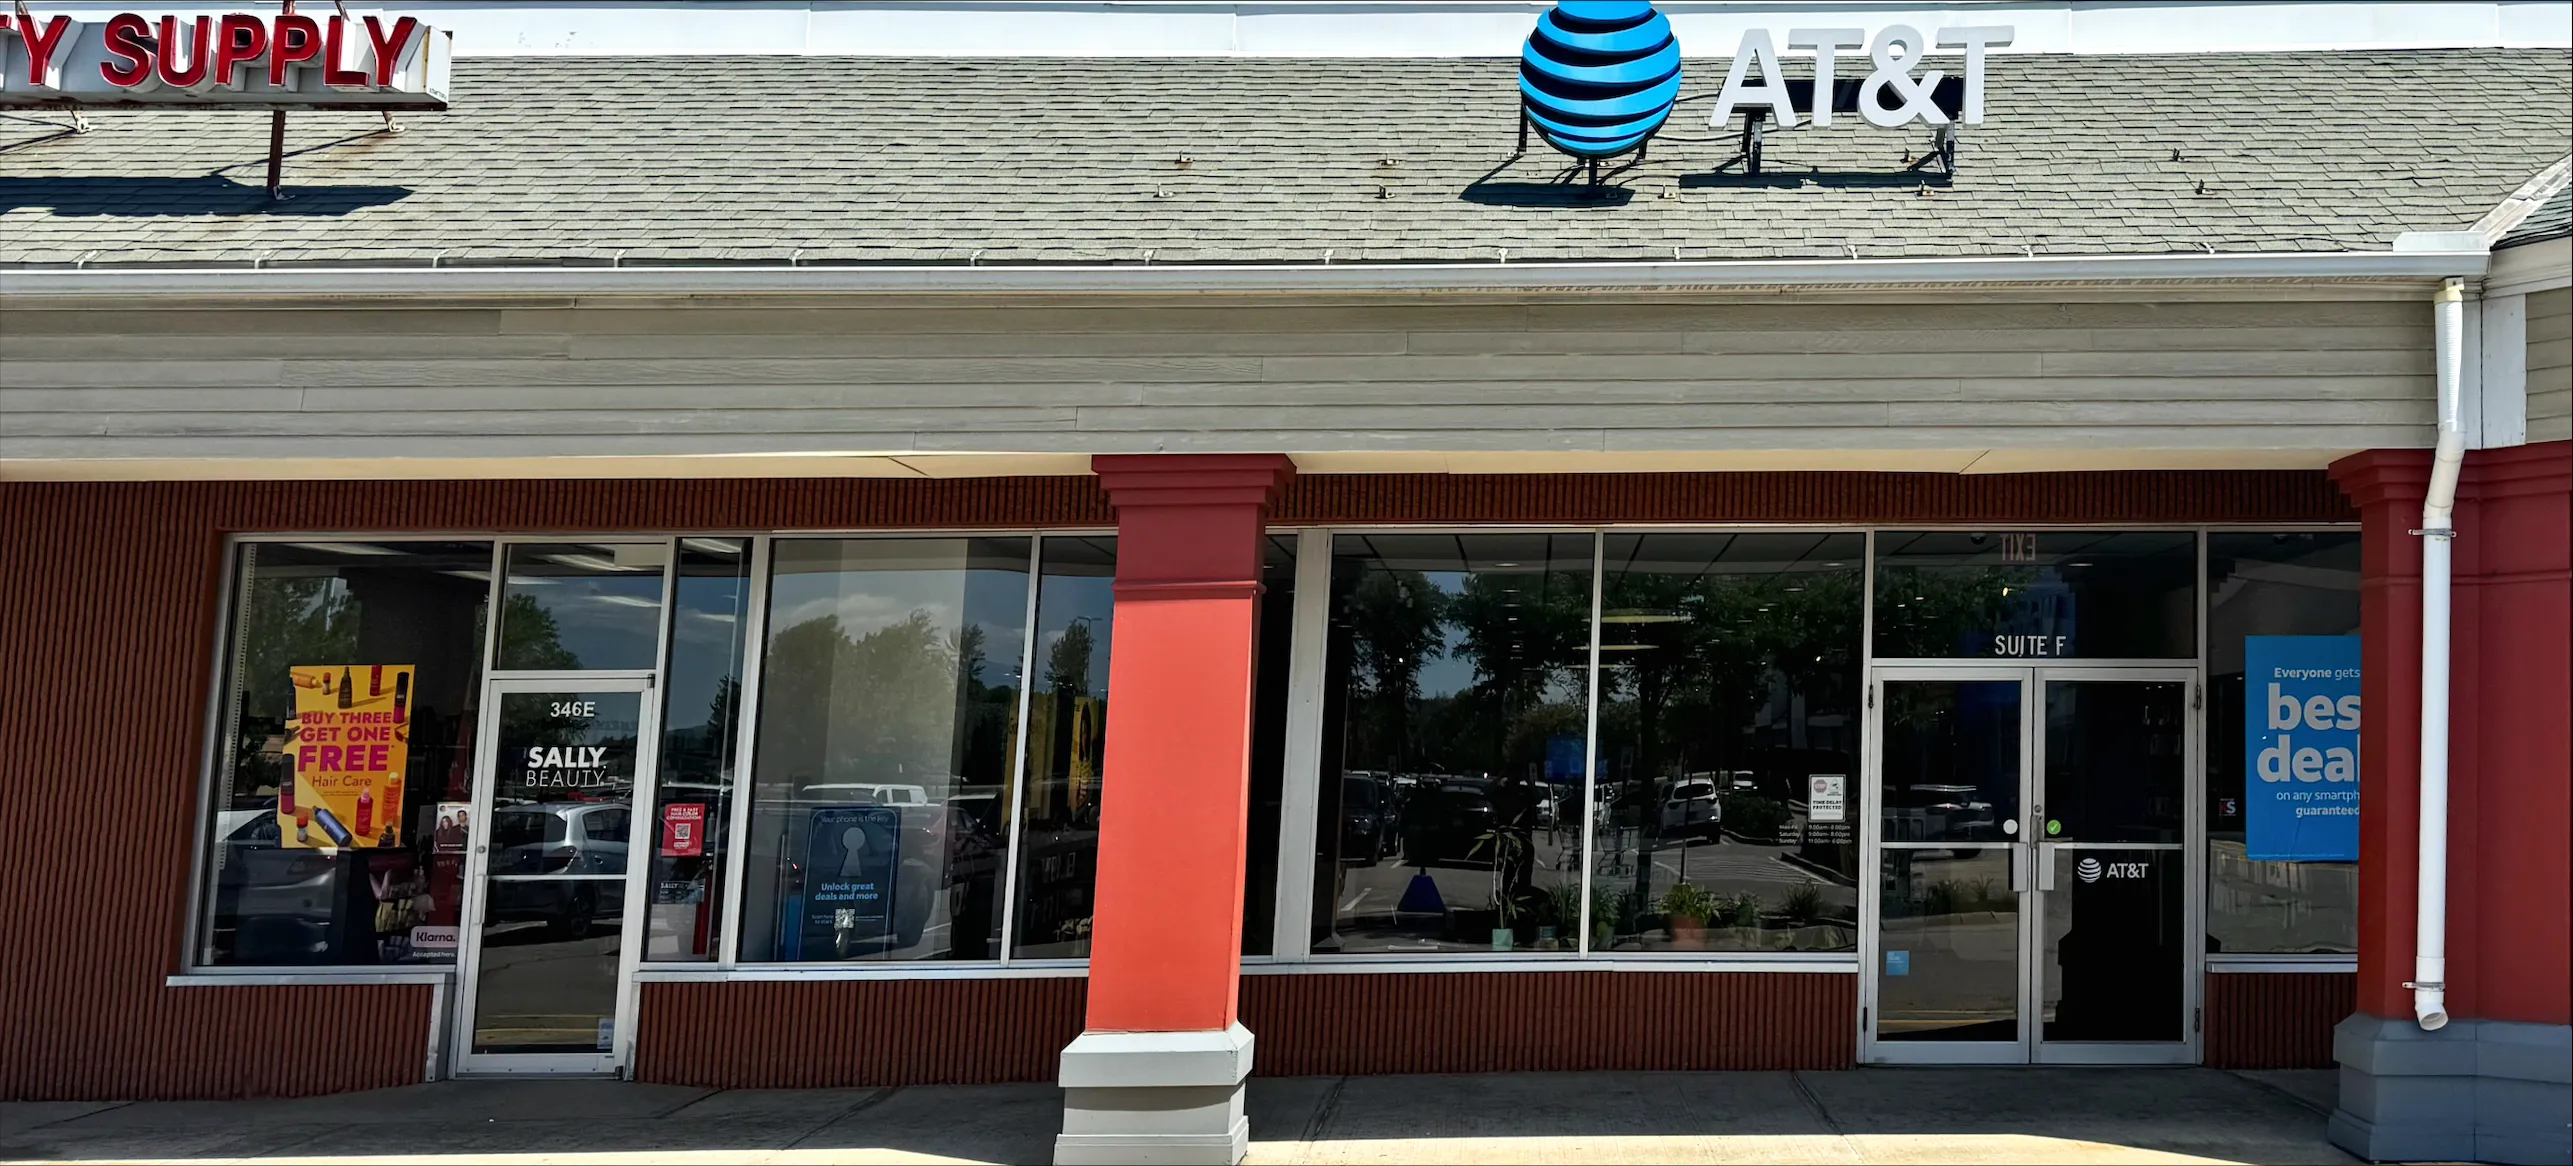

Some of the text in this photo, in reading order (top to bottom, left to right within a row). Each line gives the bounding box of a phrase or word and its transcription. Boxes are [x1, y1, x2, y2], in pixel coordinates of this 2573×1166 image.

[100, 13, 417, 88] SUPPLY
[1709, 24, 2015, 130] AT&T
[1995, 635, 2066, 657] SUITE F
[2274, 667, 2360, 680] Everyone gets
[550, 702, 596, 717] 346E
[301, 711, 392, 724] BUY THREE
[300, 726, 391, 742] GET ONE
[2256, 734, 2360, 783] dea
[312, 776, 372, 787] Hair Care
[526, 770, 605, 787] BEAUTY
[2276, 793, 2290, 801] on
[2293, 792, 2313, 803] any
[836, 815, 858, 823] phone
[2106, 863, 2149, 878] AT&T
[821, 883, 874, 892] Unlock great
[815, 892, 879, 900] deals and more
